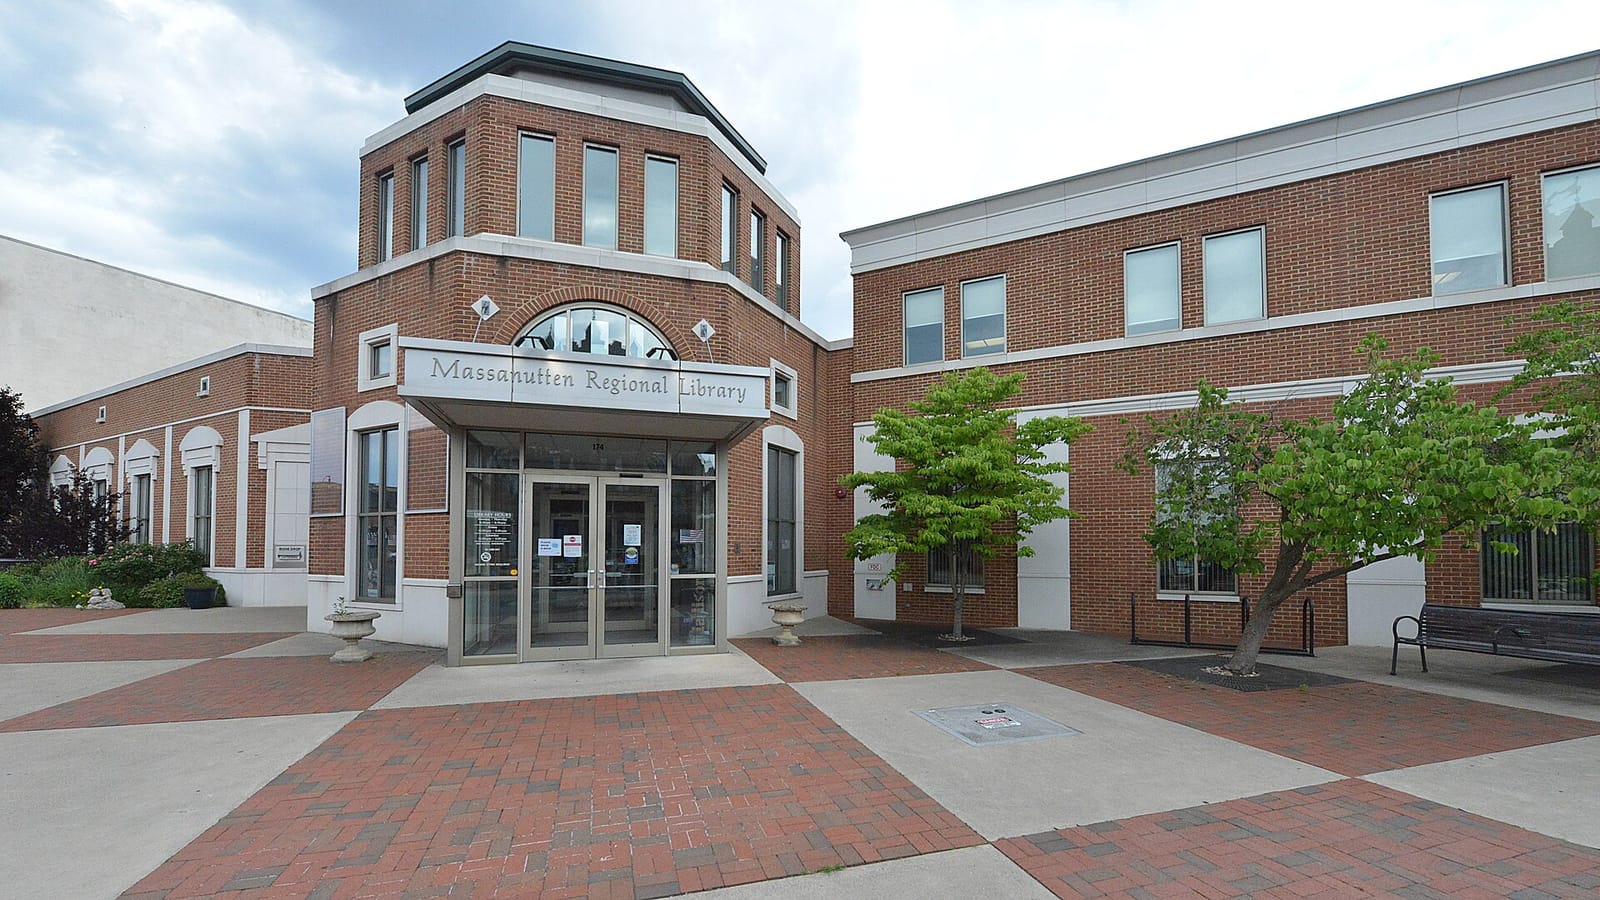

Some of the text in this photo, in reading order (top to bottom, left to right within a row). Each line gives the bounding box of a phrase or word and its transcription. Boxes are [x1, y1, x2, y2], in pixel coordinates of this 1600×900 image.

[430, 357, 747, 404] Massanutten Regional Library
